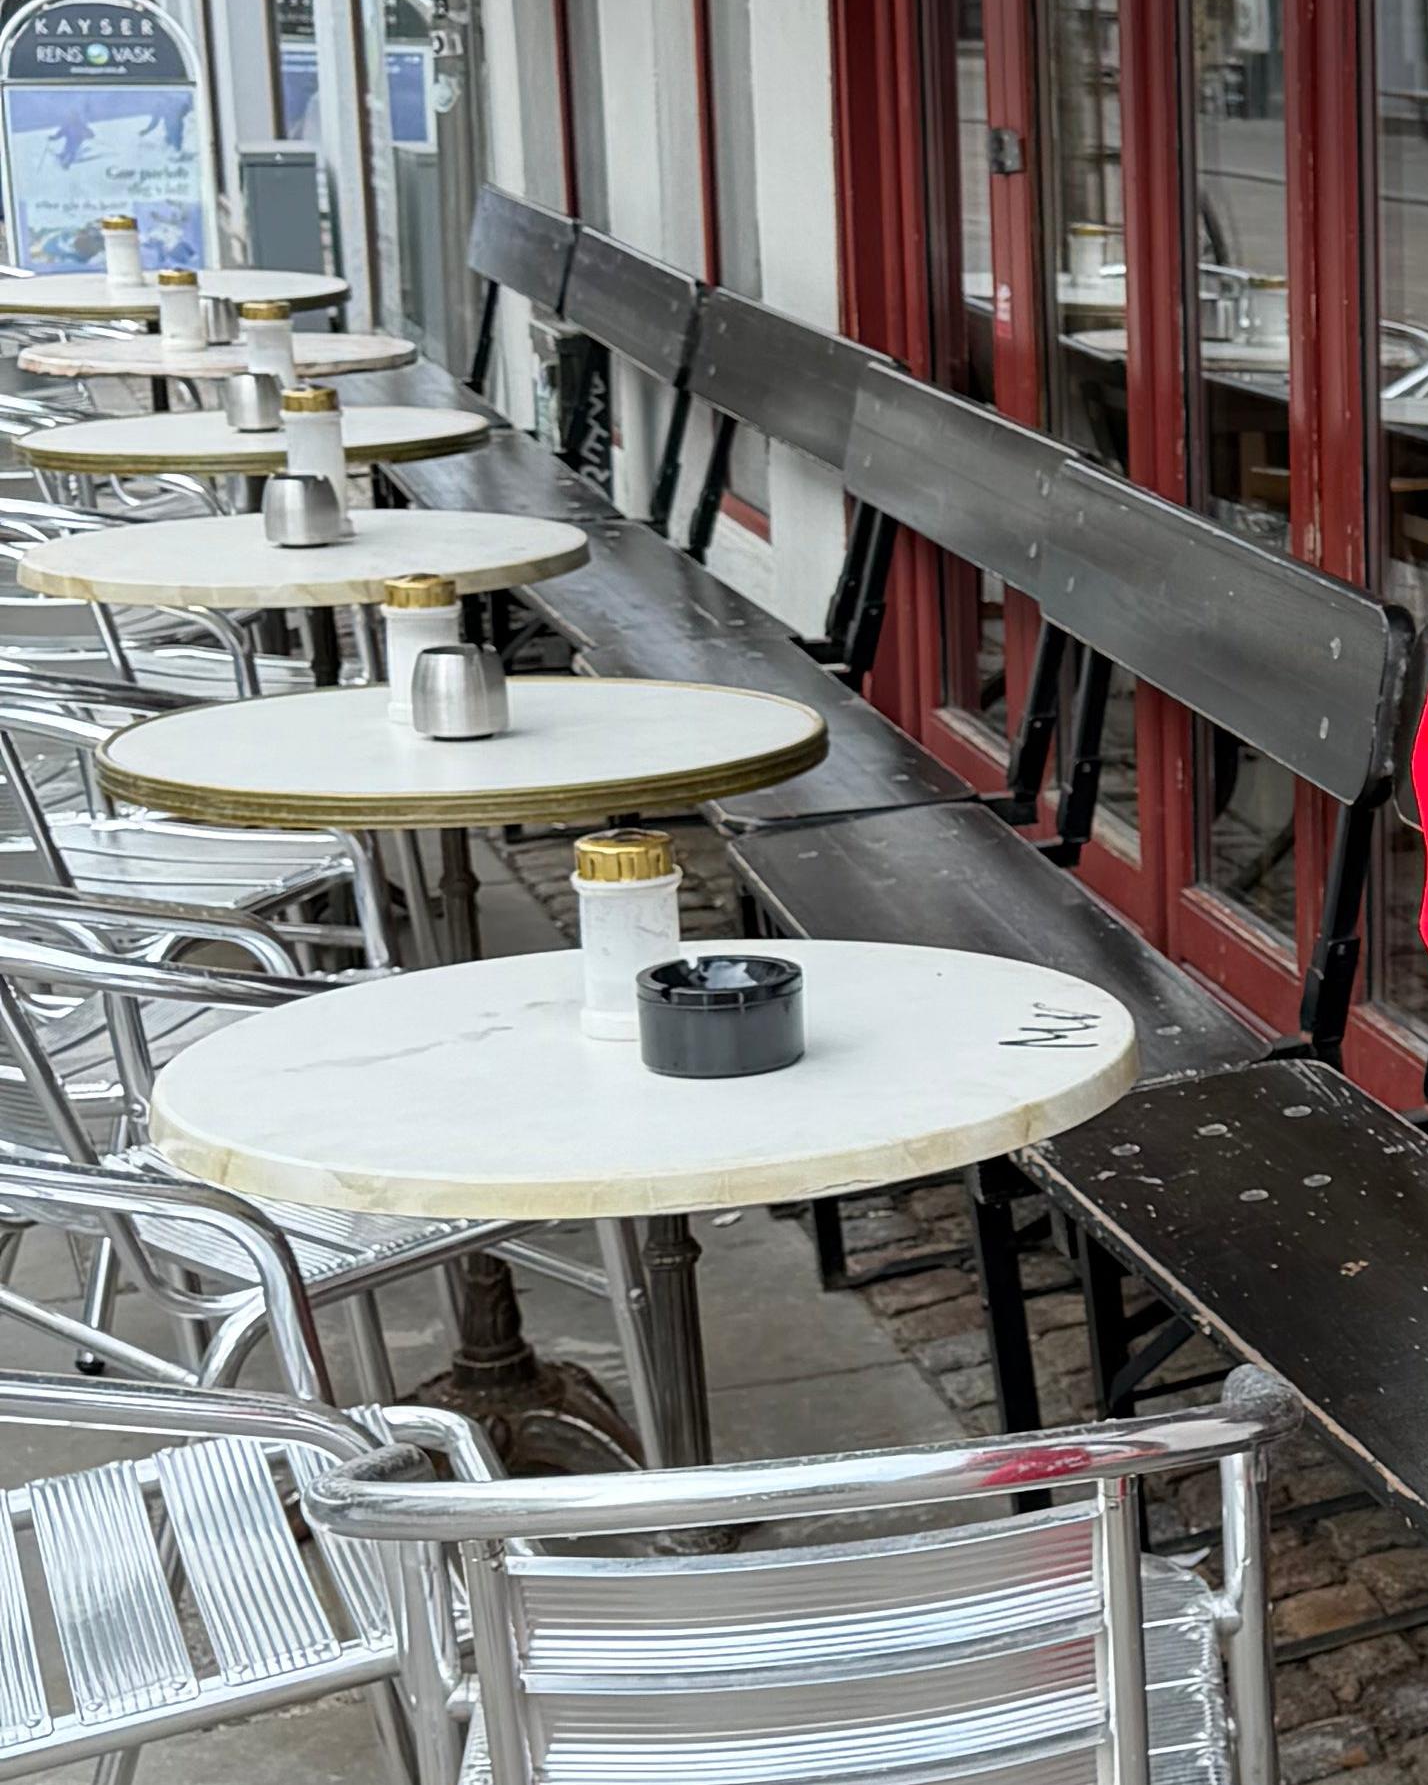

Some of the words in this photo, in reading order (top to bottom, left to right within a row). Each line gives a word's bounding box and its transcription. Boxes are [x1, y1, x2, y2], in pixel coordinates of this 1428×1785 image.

[34, 18, 154, 35] KAYSER
[36, 45, 84, 64] RENS
[111, 45, 157, 64] VASK
